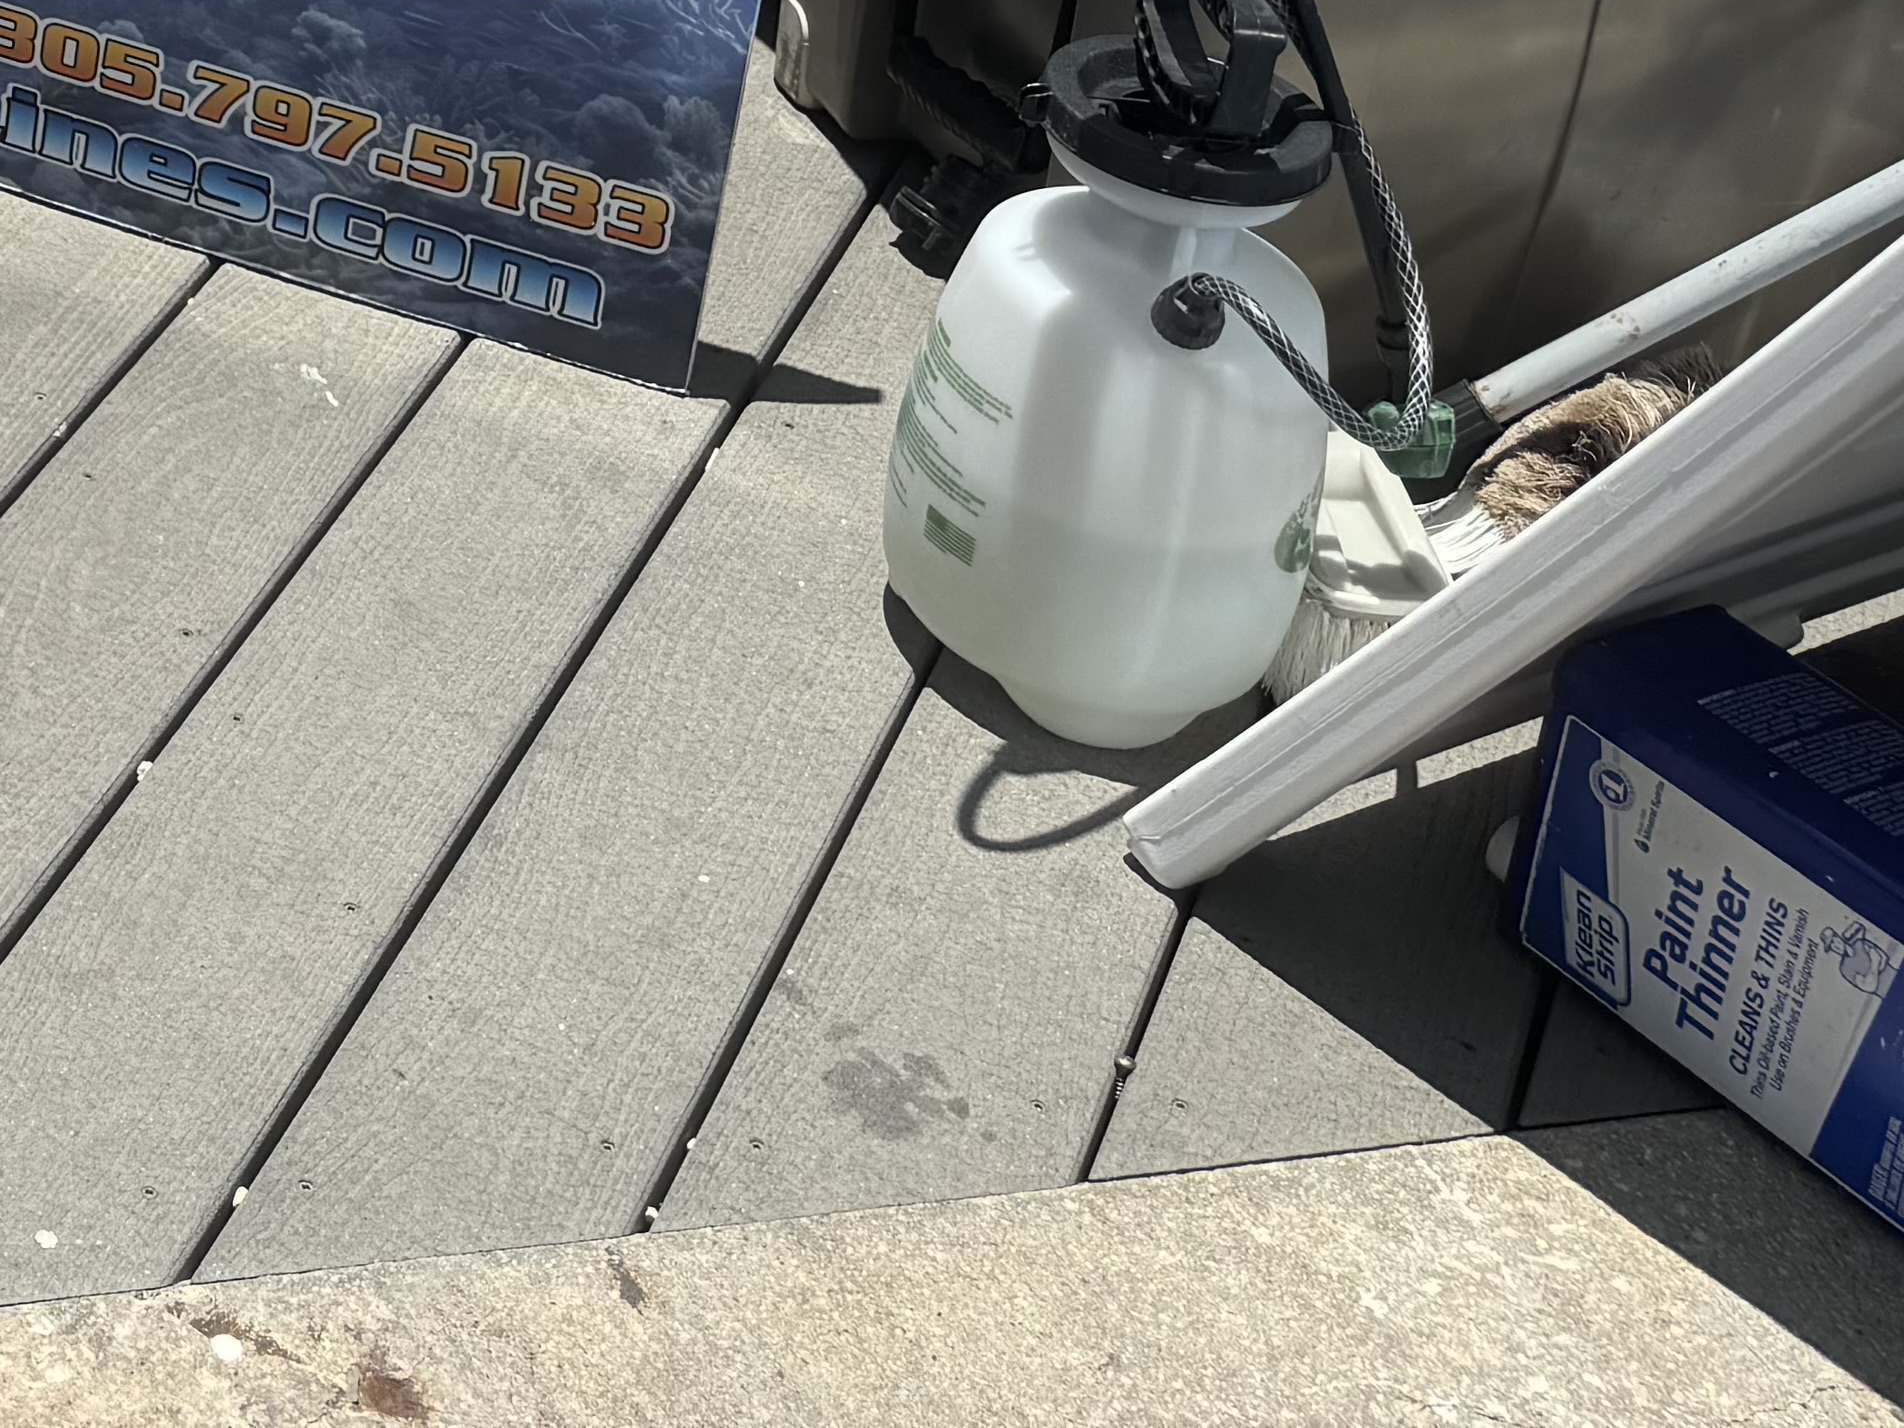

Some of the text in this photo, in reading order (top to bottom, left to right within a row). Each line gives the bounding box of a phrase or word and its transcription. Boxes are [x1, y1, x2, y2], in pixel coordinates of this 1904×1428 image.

[1574, 888, 1596, 979] Klean
[1595, 913, 1620, 987] Strip
[1642, 866, 1704, 993] Paint
[1675, 865, 1752, 1041] Thinner
[1728, 896, 1789, 1076] CLEANS & THINS
[1750, 906, 1810, 1101] Thins Oil-based Paint, Stain & Varnish
[1769, 937, 1820, 1093] Use on Brushes & Equipment
